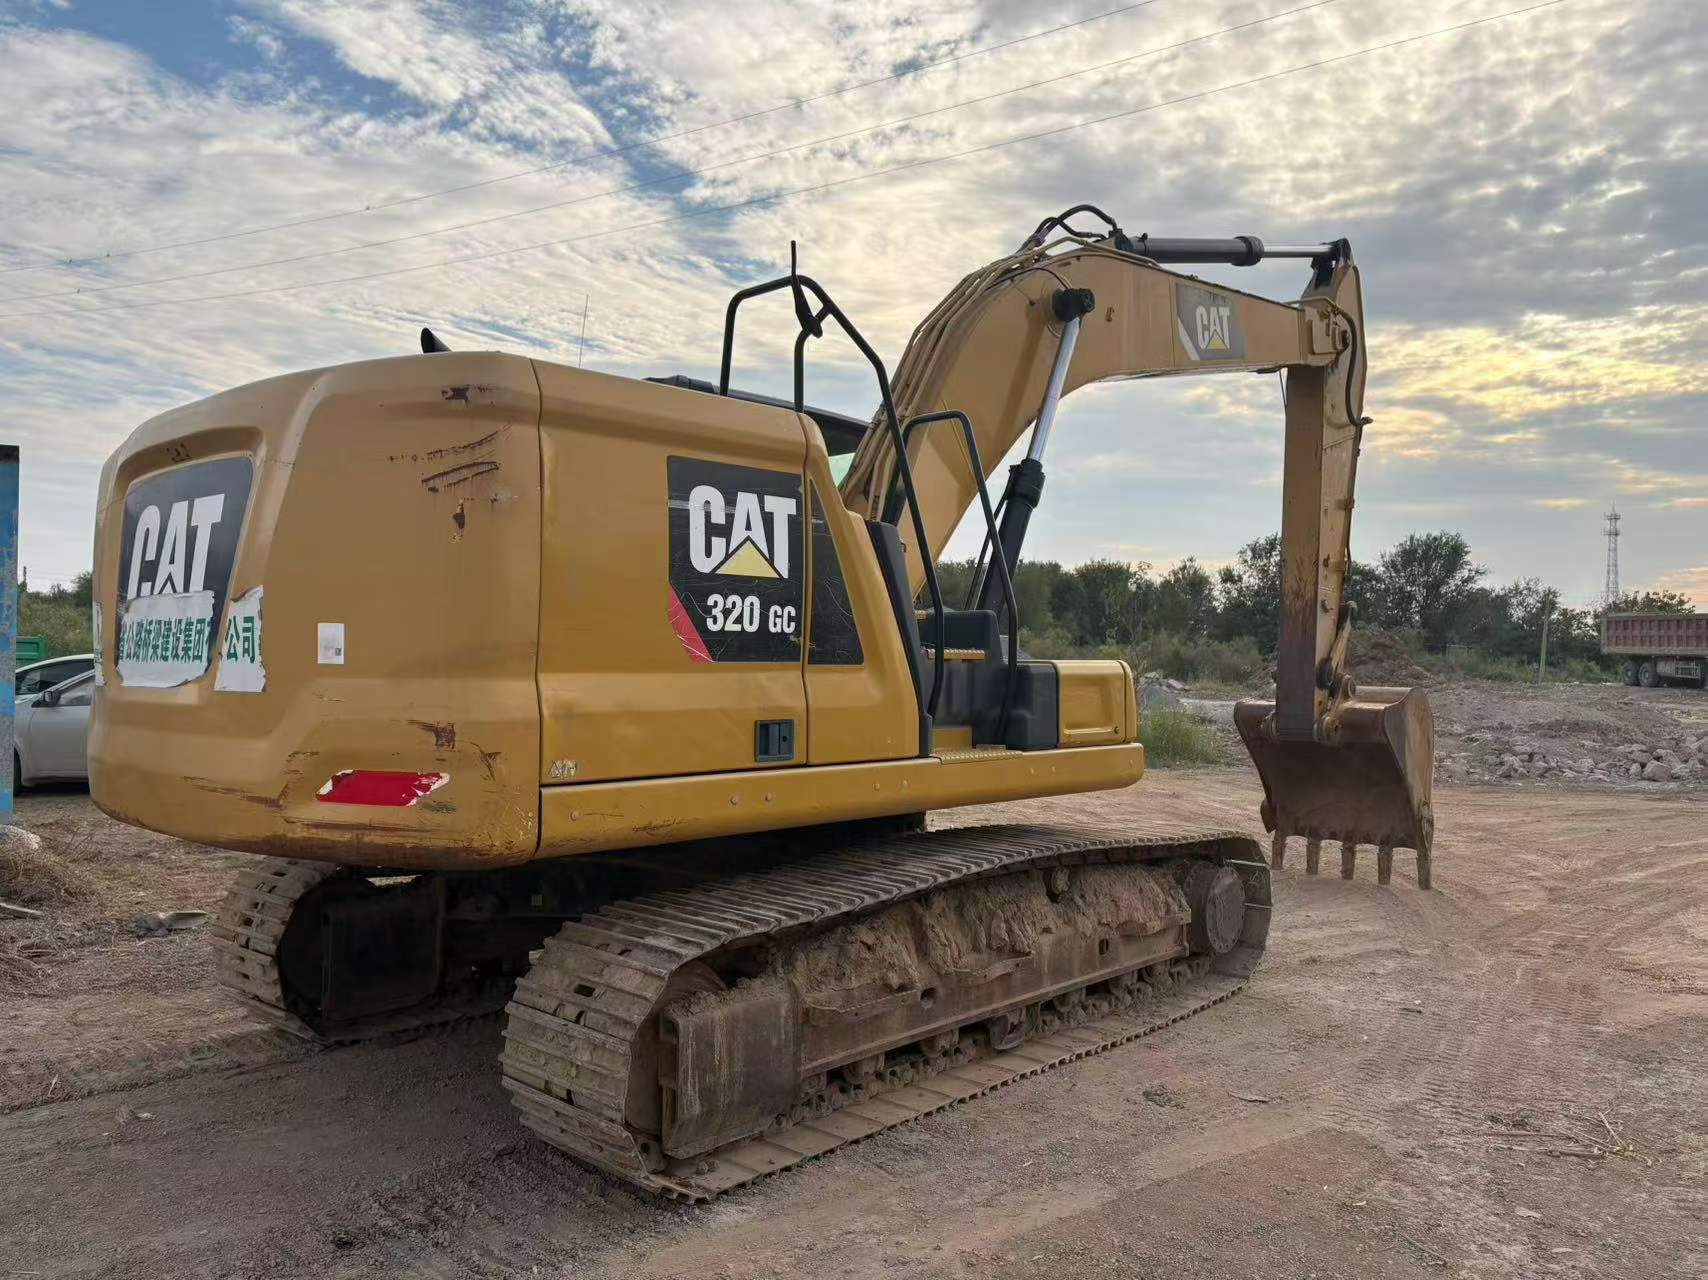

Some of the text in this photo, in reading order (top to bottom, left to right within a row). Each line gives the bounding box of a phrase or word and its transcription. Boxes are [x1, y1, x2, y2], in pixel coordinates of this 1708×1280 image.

[1196, 305, 1230, 351] CAT
[126, 493, 225, 601] CAT
[689, 485, 797, 579] CAT
[706, 593, 797, 634] 320 GC
[119, 615, 256, 664] 省公路桥梁建设集团 公司
